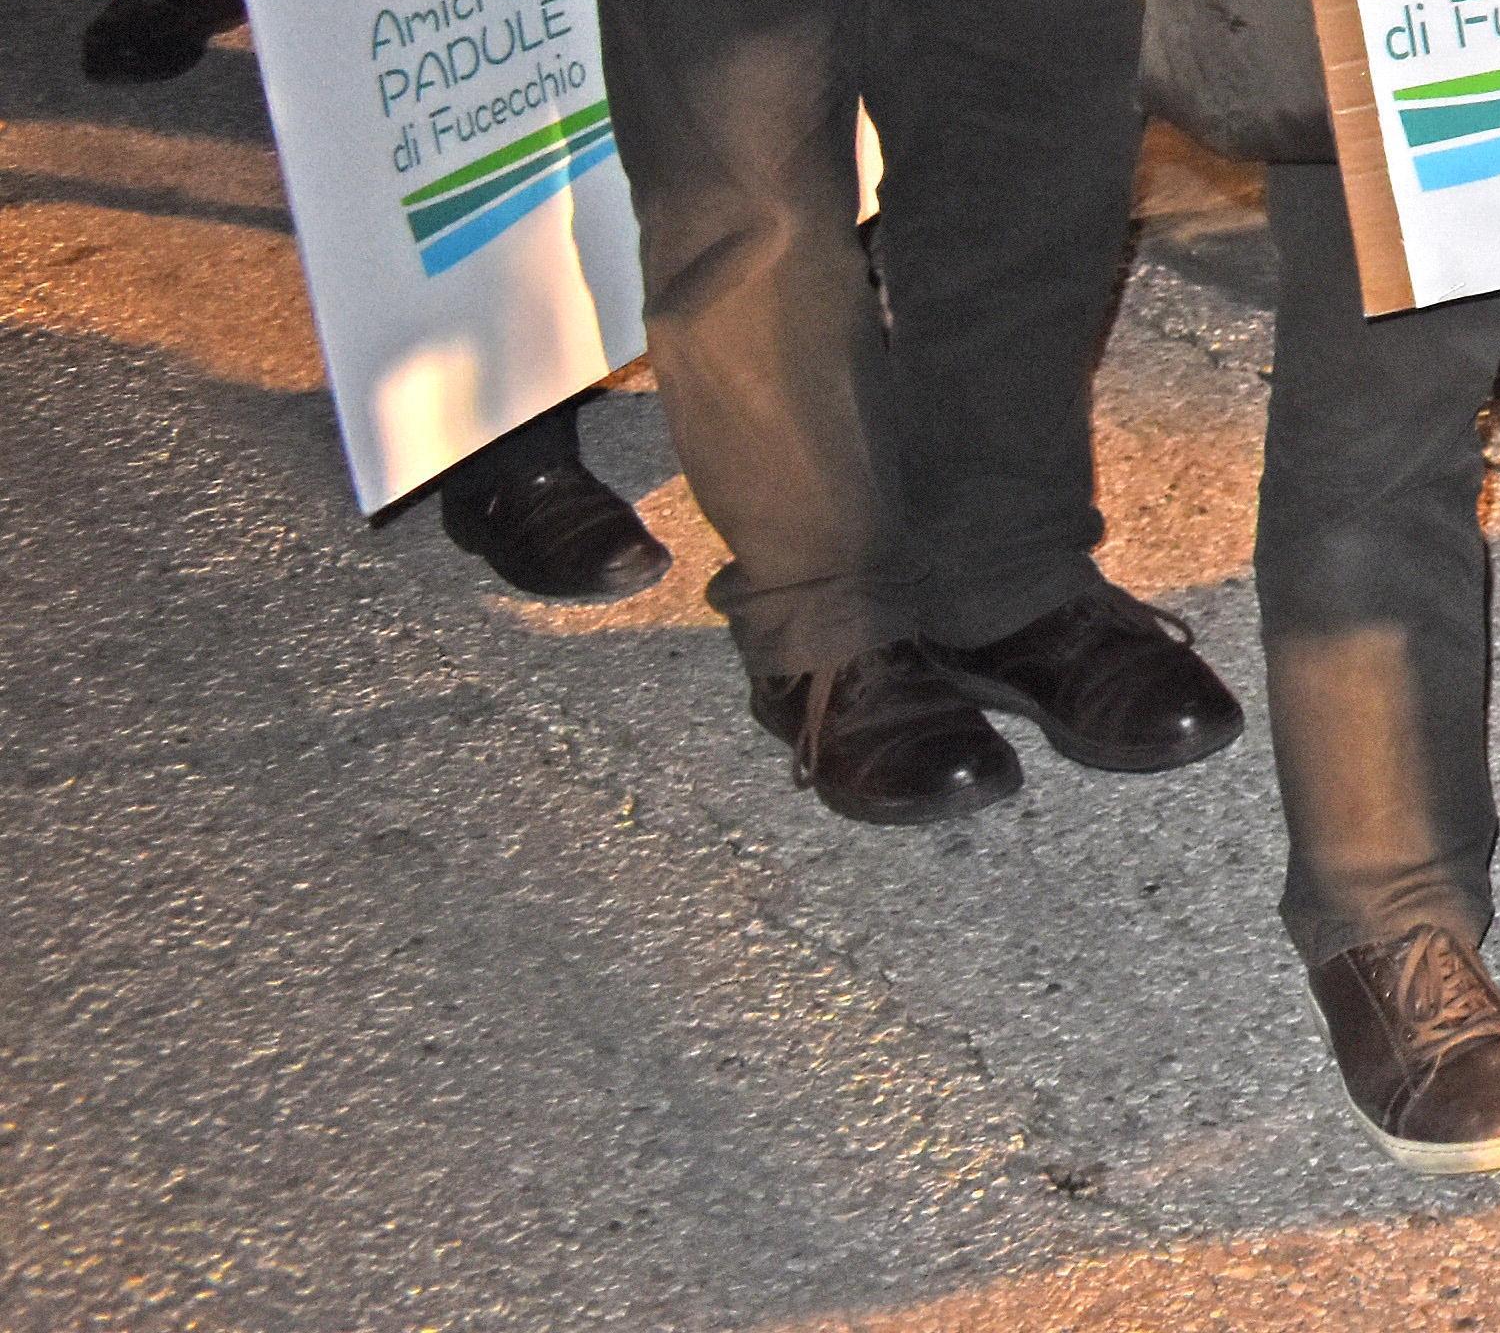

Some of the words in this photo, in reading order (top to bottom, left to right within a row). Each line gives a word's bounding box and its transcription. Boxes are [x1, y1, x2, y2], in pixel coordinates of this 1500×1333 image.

[1384, 3, 1432, 63] di
[393, 123, 421, 173] di
[429, 53, 587, 154] Fucecchio
